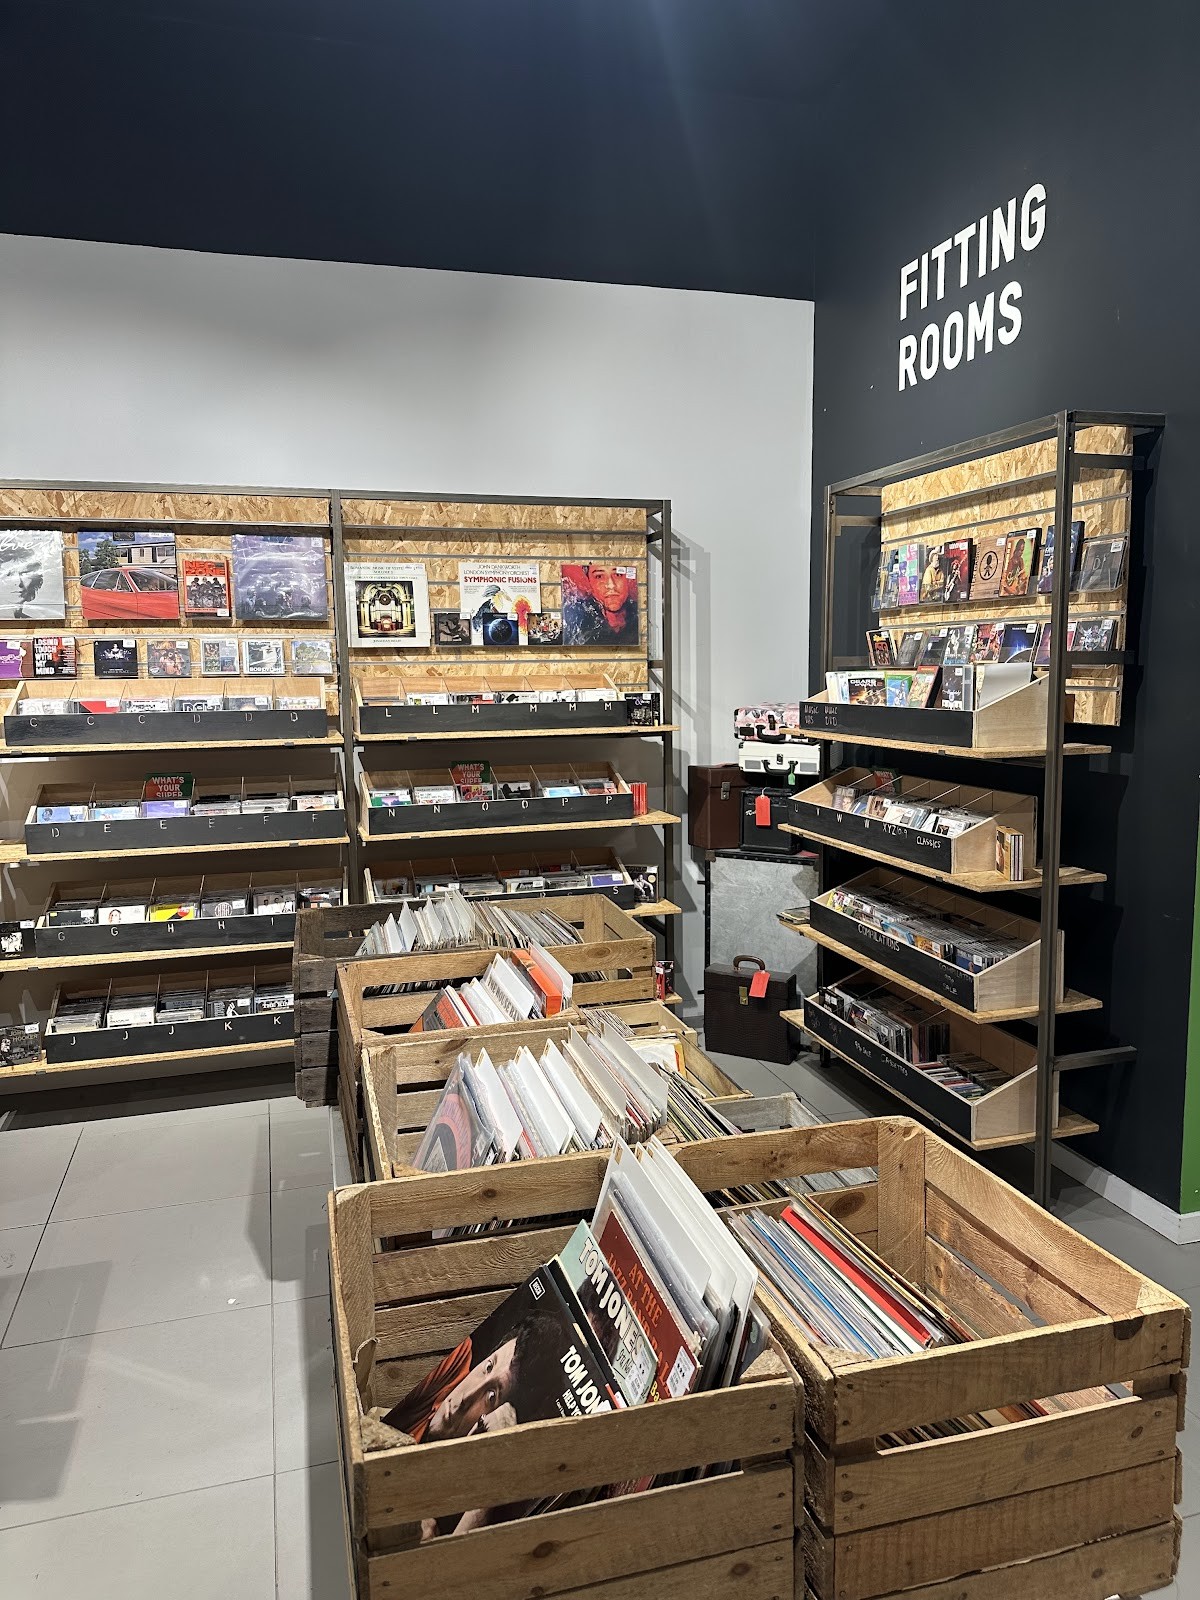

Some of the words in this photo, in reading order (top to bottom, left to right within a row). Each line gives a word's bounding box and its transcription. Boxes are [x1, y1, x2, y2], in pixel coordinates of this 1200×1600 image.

[900, 183, 1046, 321] FITTING
[898, 281, 1022, 391] ROOMS
[463, 576, 507, 584] SYMPHONIC
[508, 576, 537, 584] FUSIONS
[34, 638, 59, 646] LOSING
[35, 653, 53, 661] WITH
[35, 667, 55, 675] MIND
[432, 705, 438, 715] L
[471, 705, 480, 714] M
[529, 704, 538, 713] M
[569, 703, 577, 712] M
[604, 702, 612, 711] M
[290, 711, 298, 722] D
[385, 707, 392, 718] L
[29, 717, 38, 727] C
[86, 716, 95, 725] C
[138, 714, 146, 724] C
[824, 715, 838, 727] DVD
[458, 763, 484, 771] WHAT'S
[152, 776, 185, 784] WHAT'S
[158, 784, 180, 792] YOUR
[521, 799, 529, 809] O
[561, 797, 569, 807] P
[605, 795, 613, 805] P
[433, 805, 441, 813] N
[481, 801, 489, 811] O
[794, 803, 799, 813] U
[311, 813, 318, 822] F
[388, 808, 396, 817] N
[208, 817, 215, 828] E
[263, 815, 270, 824] F
[836, 813, 843, 823] W
[103, 823, 112, 833] E
[159, 819, 168, 830] E
[864, 819, 870, 829] W
[51, 827, 60, 838] D
[916, 835, 942, 849] CLASSICS
[613, 886, 619, 895] S
[167, 923, 175, 934] H
[218, 920, 226, 930] H
[57, 931, 65, 941] G
[110, 926, 118, 936] G
[857, 923, 900, 952] COMPILATIONS
[273, 1016, 281, 1025] K
[168, 1025, 175, 1035] J
[224, 1021, 232, 1031] K
[12, 1033, 38, 1042] HOOKER
[123, 1030, 128, 1040] J
[70, 1036, 76, 1046] J
[579, 1236, 609, 1295] TOM
[608, 1253, 628, 1289] JAZZ
[629, 1263, 644, 1291] AT
[640, 1282, 663, 1328] THE
[559, 1344, 589, 1389] TOM
[561, 1388, 577, 1410] HELP
